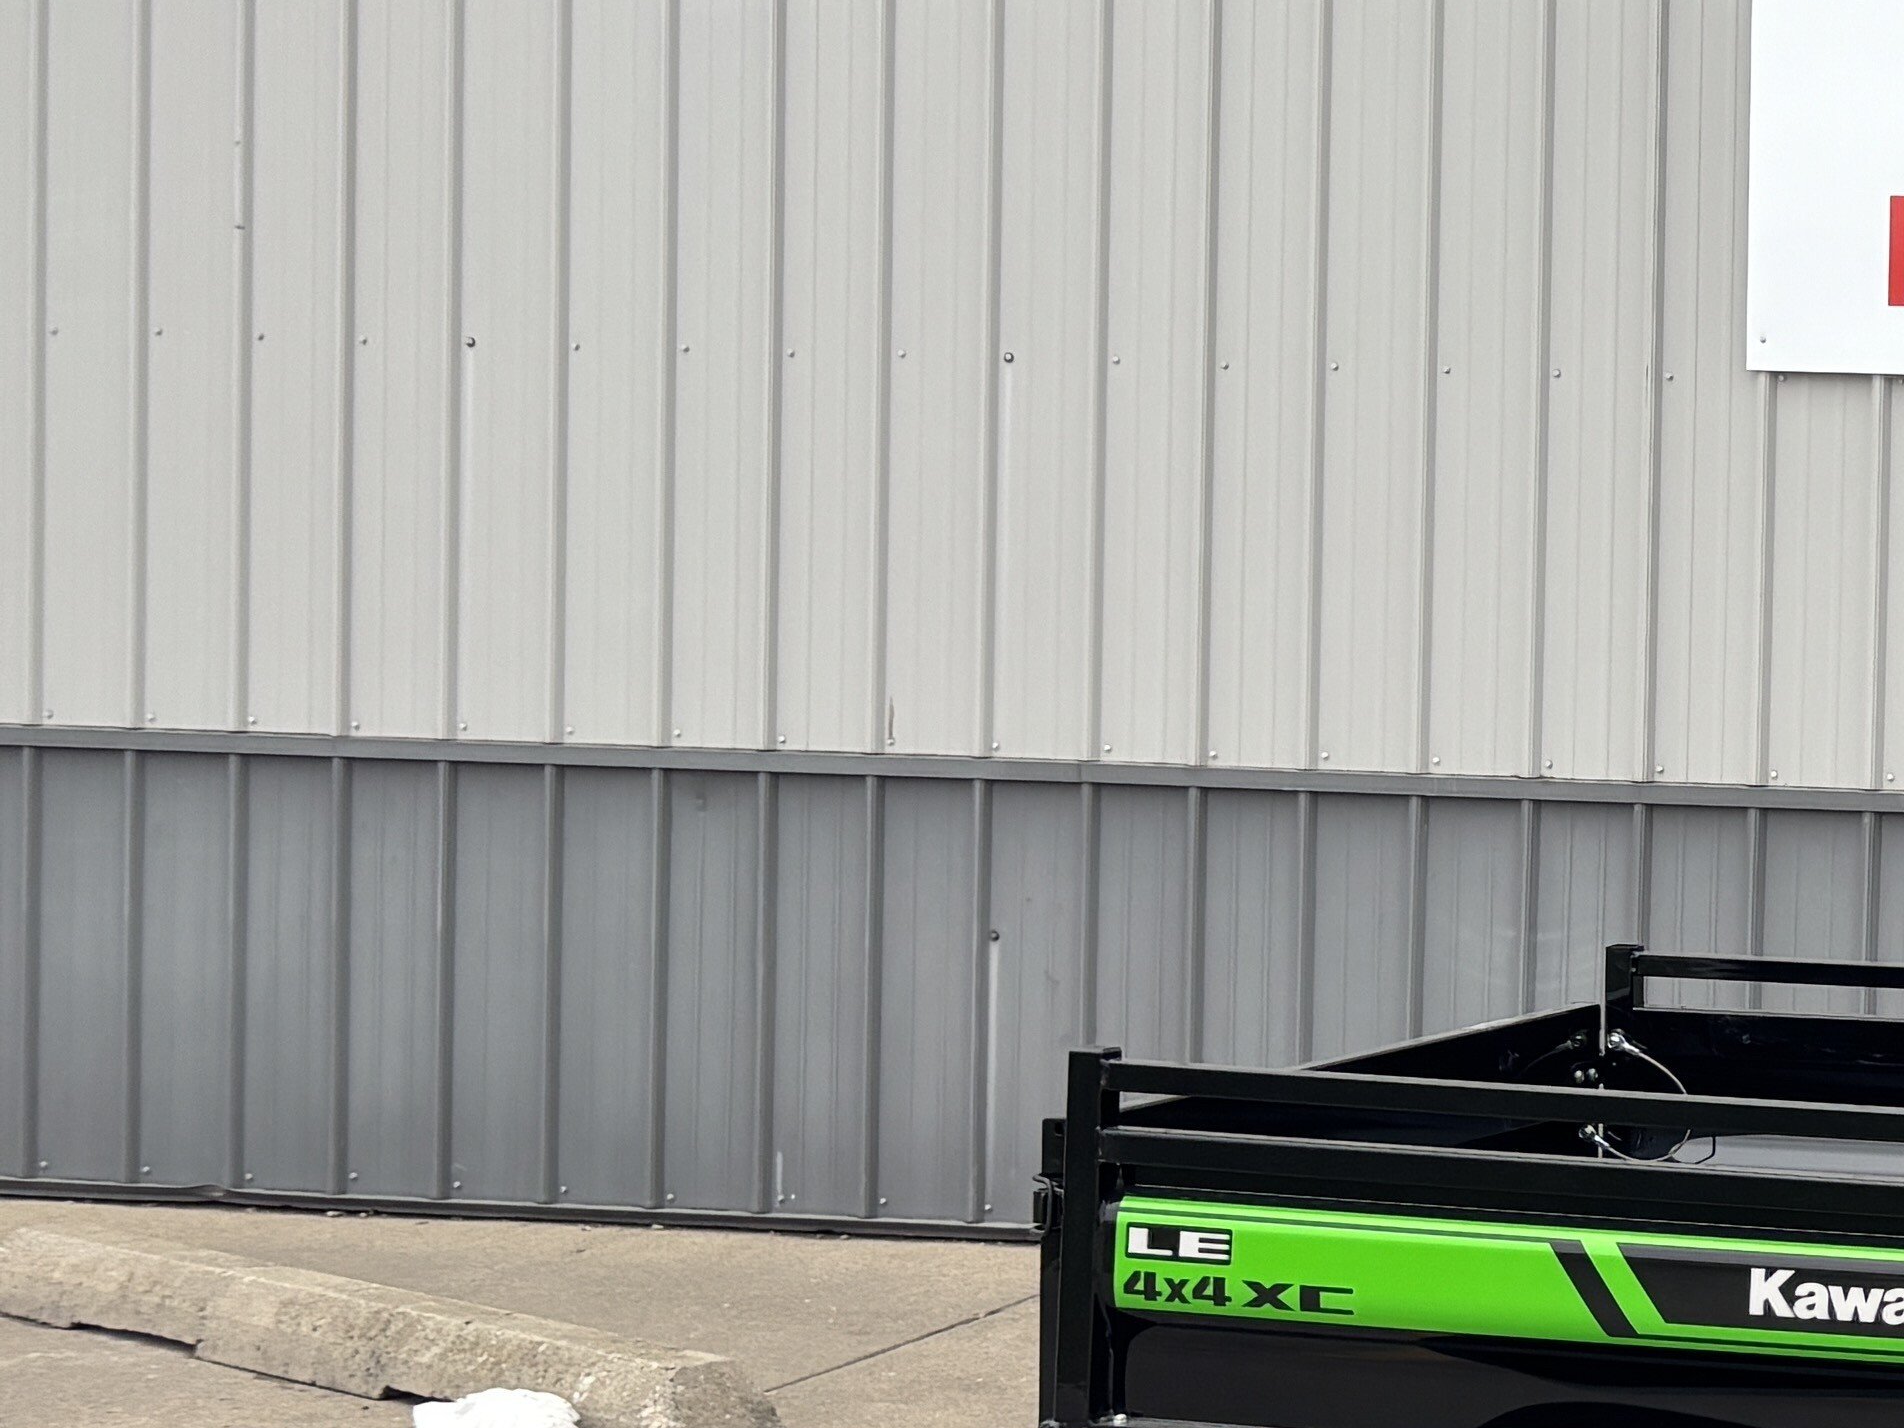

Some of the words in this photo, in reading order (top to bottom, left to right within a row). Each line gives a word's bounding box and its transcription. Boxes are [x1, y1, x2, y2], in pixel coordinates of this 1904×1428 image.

[1127, 1227, 1231, 1261] LE
[1123, 1269, 1232, 1307] 4x4
[1241, 1279, 1355, 1316] XC
